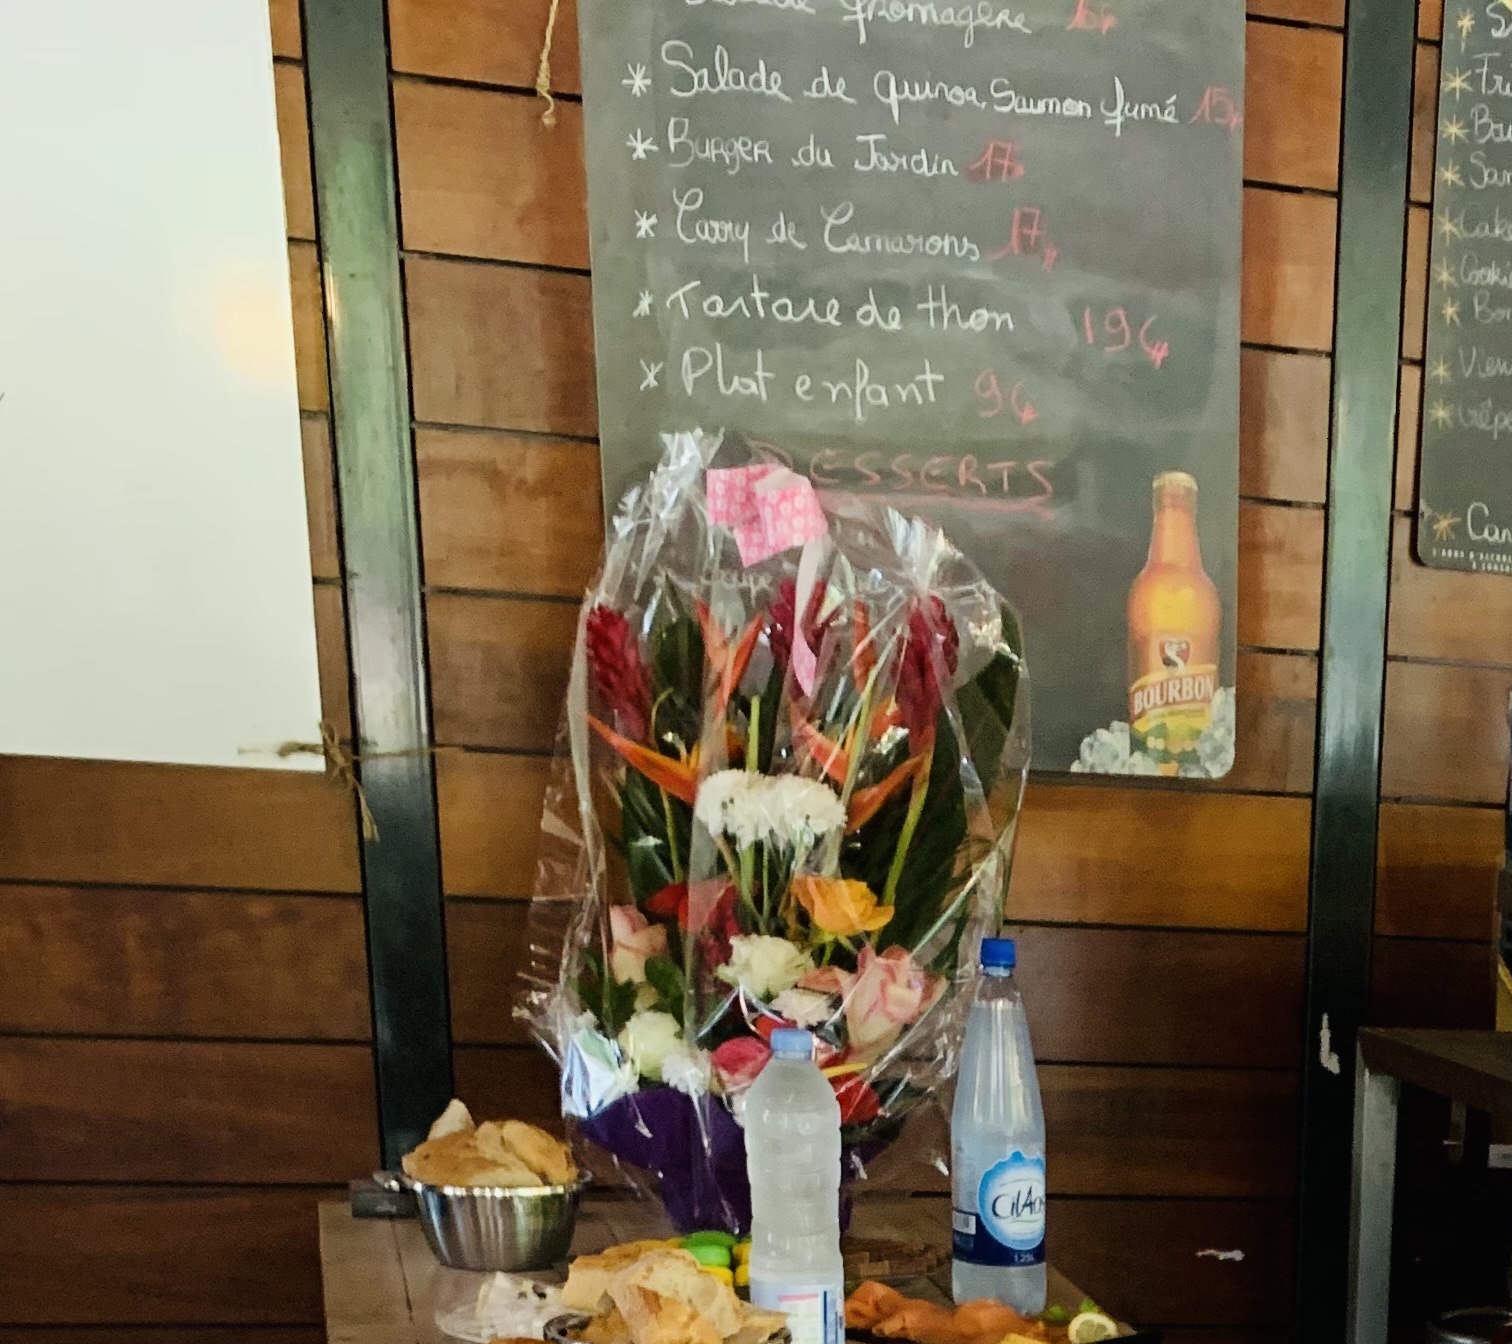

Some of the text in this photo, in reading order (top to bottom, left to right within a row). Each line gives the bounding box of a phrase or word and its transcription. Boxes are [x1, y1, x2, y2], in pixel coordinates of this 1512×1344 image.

[661, 40, 792, 101] Salade
[803, 66, 857, 104] de
[791, 134, 834, 168] du
[854, 133, 959, 177] Jardin
[766, 211, 806, 250] de
[667, 275, 842, 328] Tartare
[856, 288, 902, 331] de
[917, 285, 1014, 331] thon
[1132, 673, 1214, 720] BOURBON
